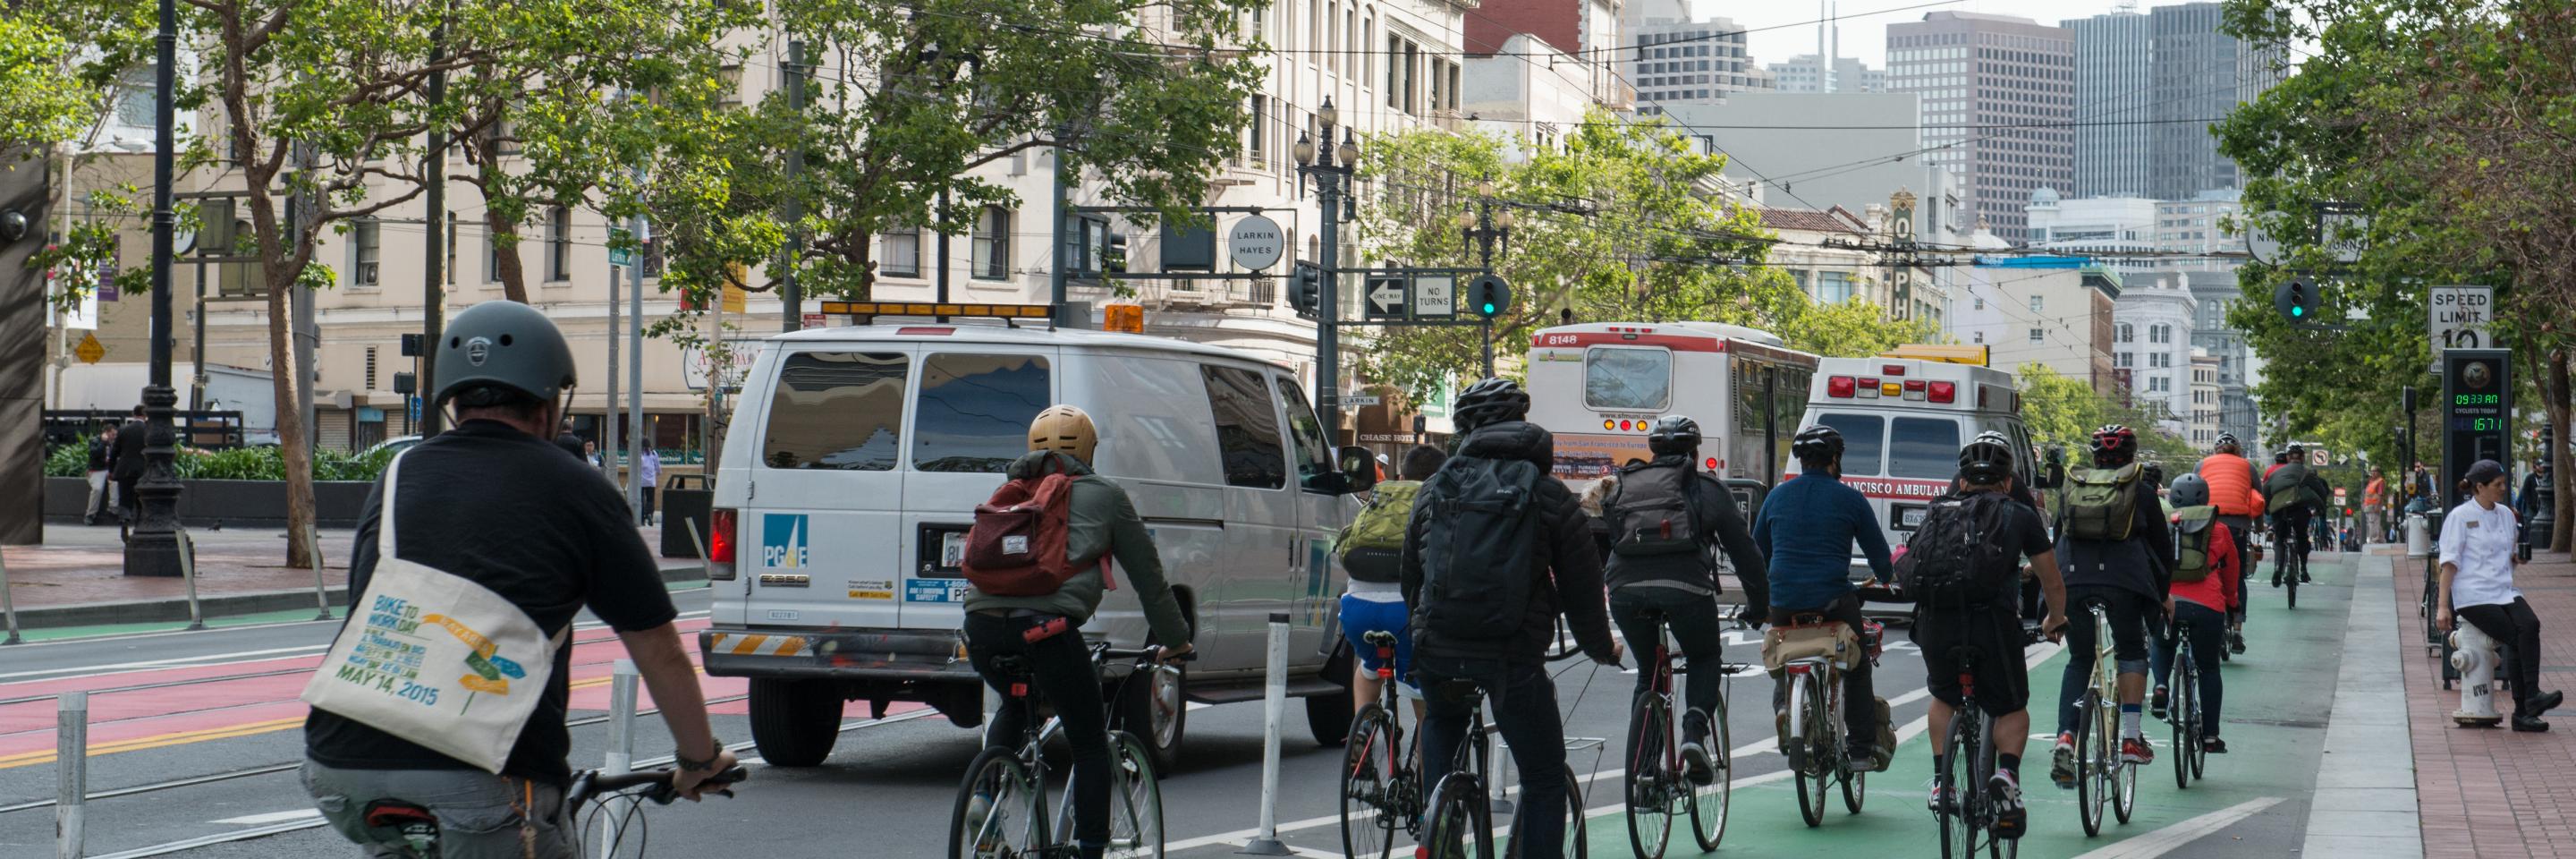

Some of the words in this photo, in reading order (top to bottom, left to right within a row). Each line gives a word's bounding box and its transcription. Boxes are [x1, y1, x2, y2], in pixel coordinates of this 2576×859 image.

[1237, 232, 1275, 240] LARKIN
[1239, 246, 1273, 254] HAYES
[1428, 287, 1440, 295] NO
[1419, 297, 1449, 306] TURNS
[2435, 293, 2487, 306] SPEED
[2440, 311, 2481, 323] LIMIT
[1548, 335, 1578, 344] 8148
[2442, 328, 2479, 349] 10
[1599, 412, 1657, 421] www.sfmuni.com
[1360, 434, 1392, 442] CHASE
[1394, 434, 1415, 442] HOTE
[1842, 480, 1893, 494] ANCISCO
[1895, 483, 1948, 497] AMBULAN
[764, 545, 808, 569] PG&E
[374, 594, 408, 616] BIKE
[403, 605, 419, 619] TO
[368, 613, 401, 629] WORK
[396, 618, 421, 634] DAY
[335, 662, 377, 686] MAY
[375, 674, 395, 697] 14,
[397, 680, 440, 706] 2015
